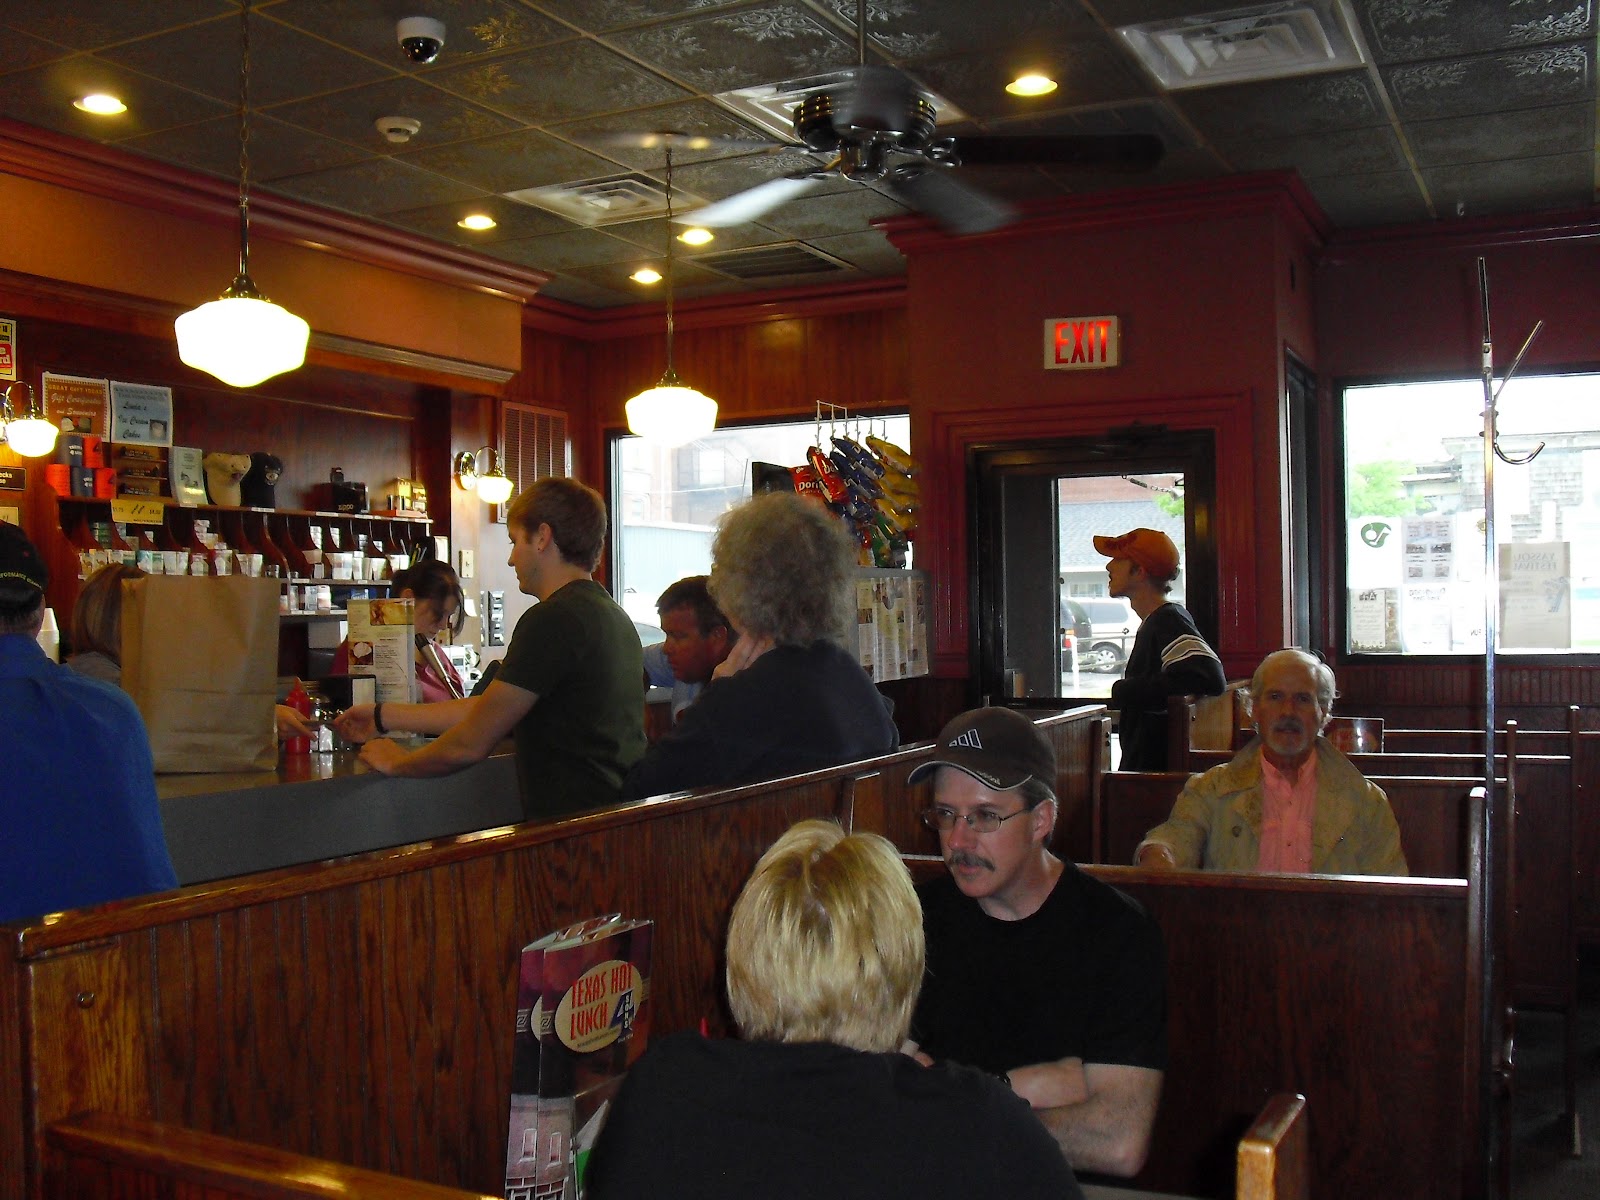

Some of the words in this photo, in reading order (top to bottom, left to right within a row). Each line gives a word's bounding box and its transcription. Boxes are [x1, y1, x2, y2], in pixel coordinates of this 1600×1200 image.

[1054, 319, 1112, 364] EXIT
[571, 971, 607, 1009] TEXAS
[611, 962, 635, 995] HOT
[570, 1001, 608, 1041] LUNCH
